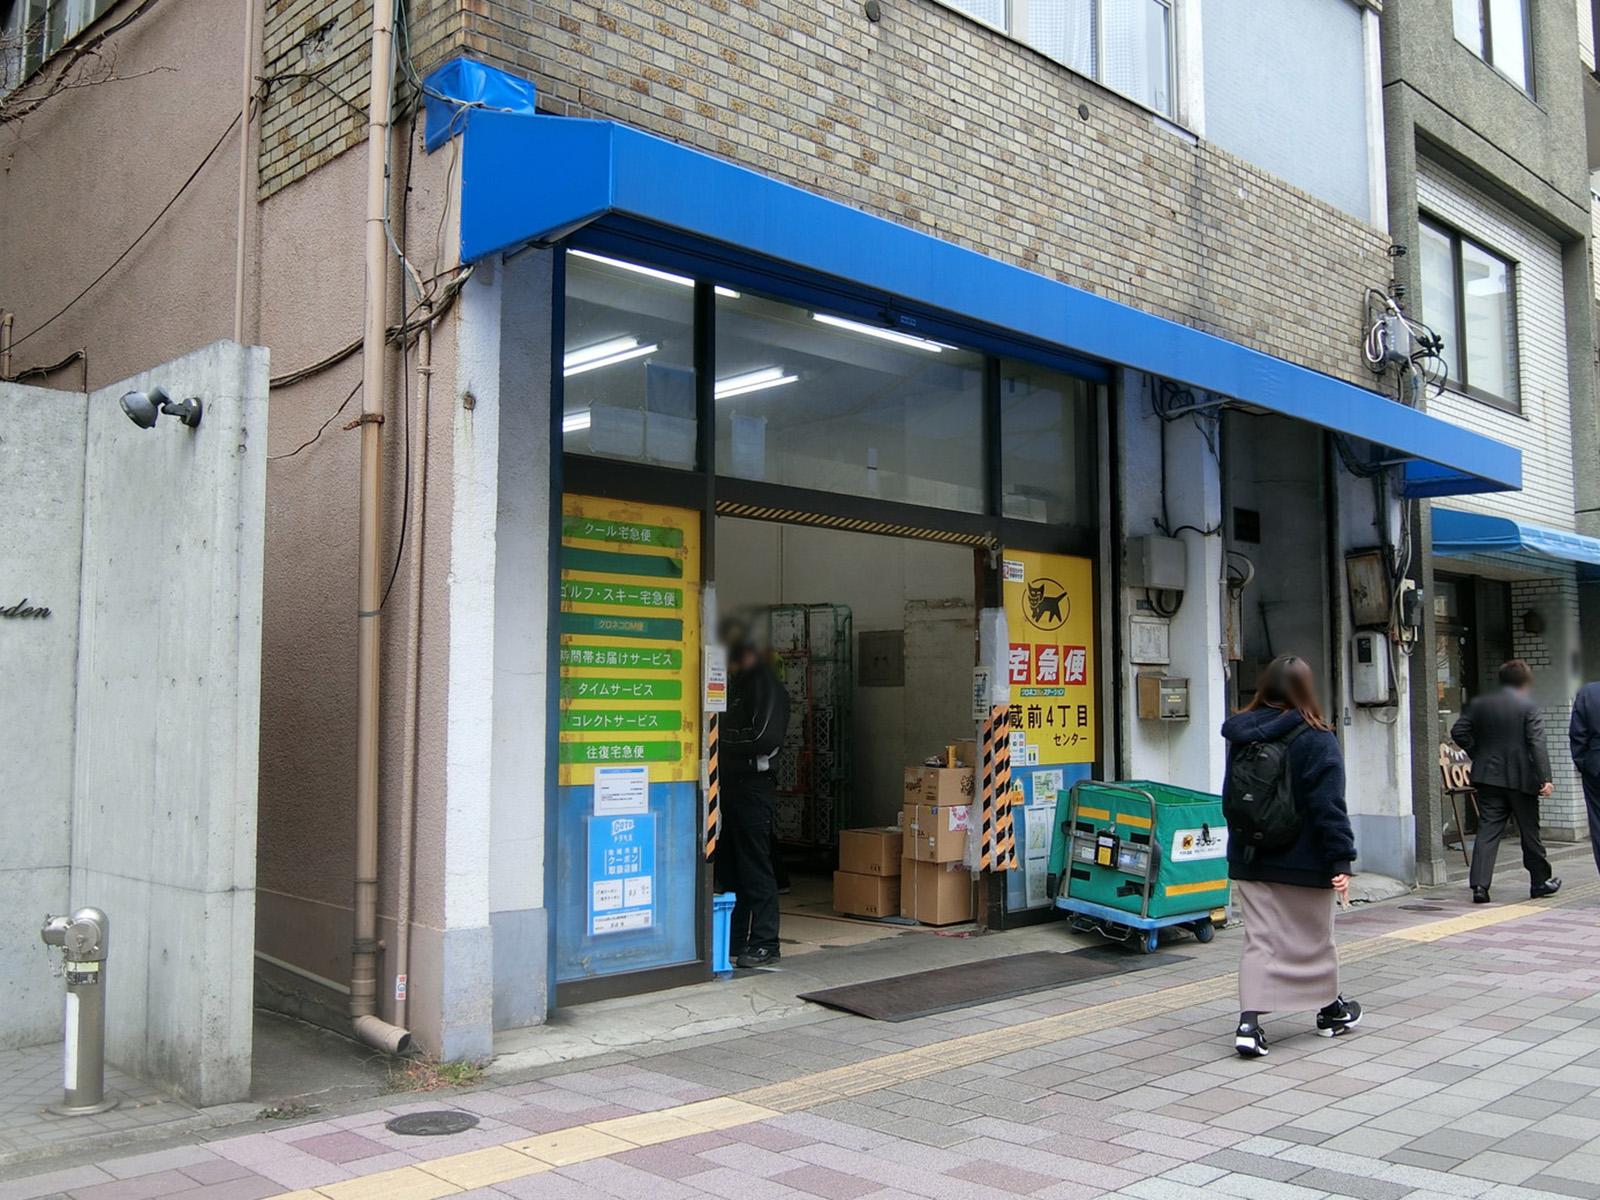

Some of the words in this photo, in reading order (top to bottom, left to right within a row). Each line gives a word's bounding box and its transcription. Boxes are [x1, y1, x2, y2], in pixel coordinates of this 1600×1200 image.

[584, 522, 652, 542] クール宅急便
[560, 649, 673, 666] 時間帯お届けサービス
[1009, 647, 1086, 682] 宅急便
[578, 682, 654, 697] タイムサービス
[571, 715, 658, 728] コレクトサービス
[1053, 733, 1088, 747] センター
[586, 745, 645, 760] 往復宅急便
